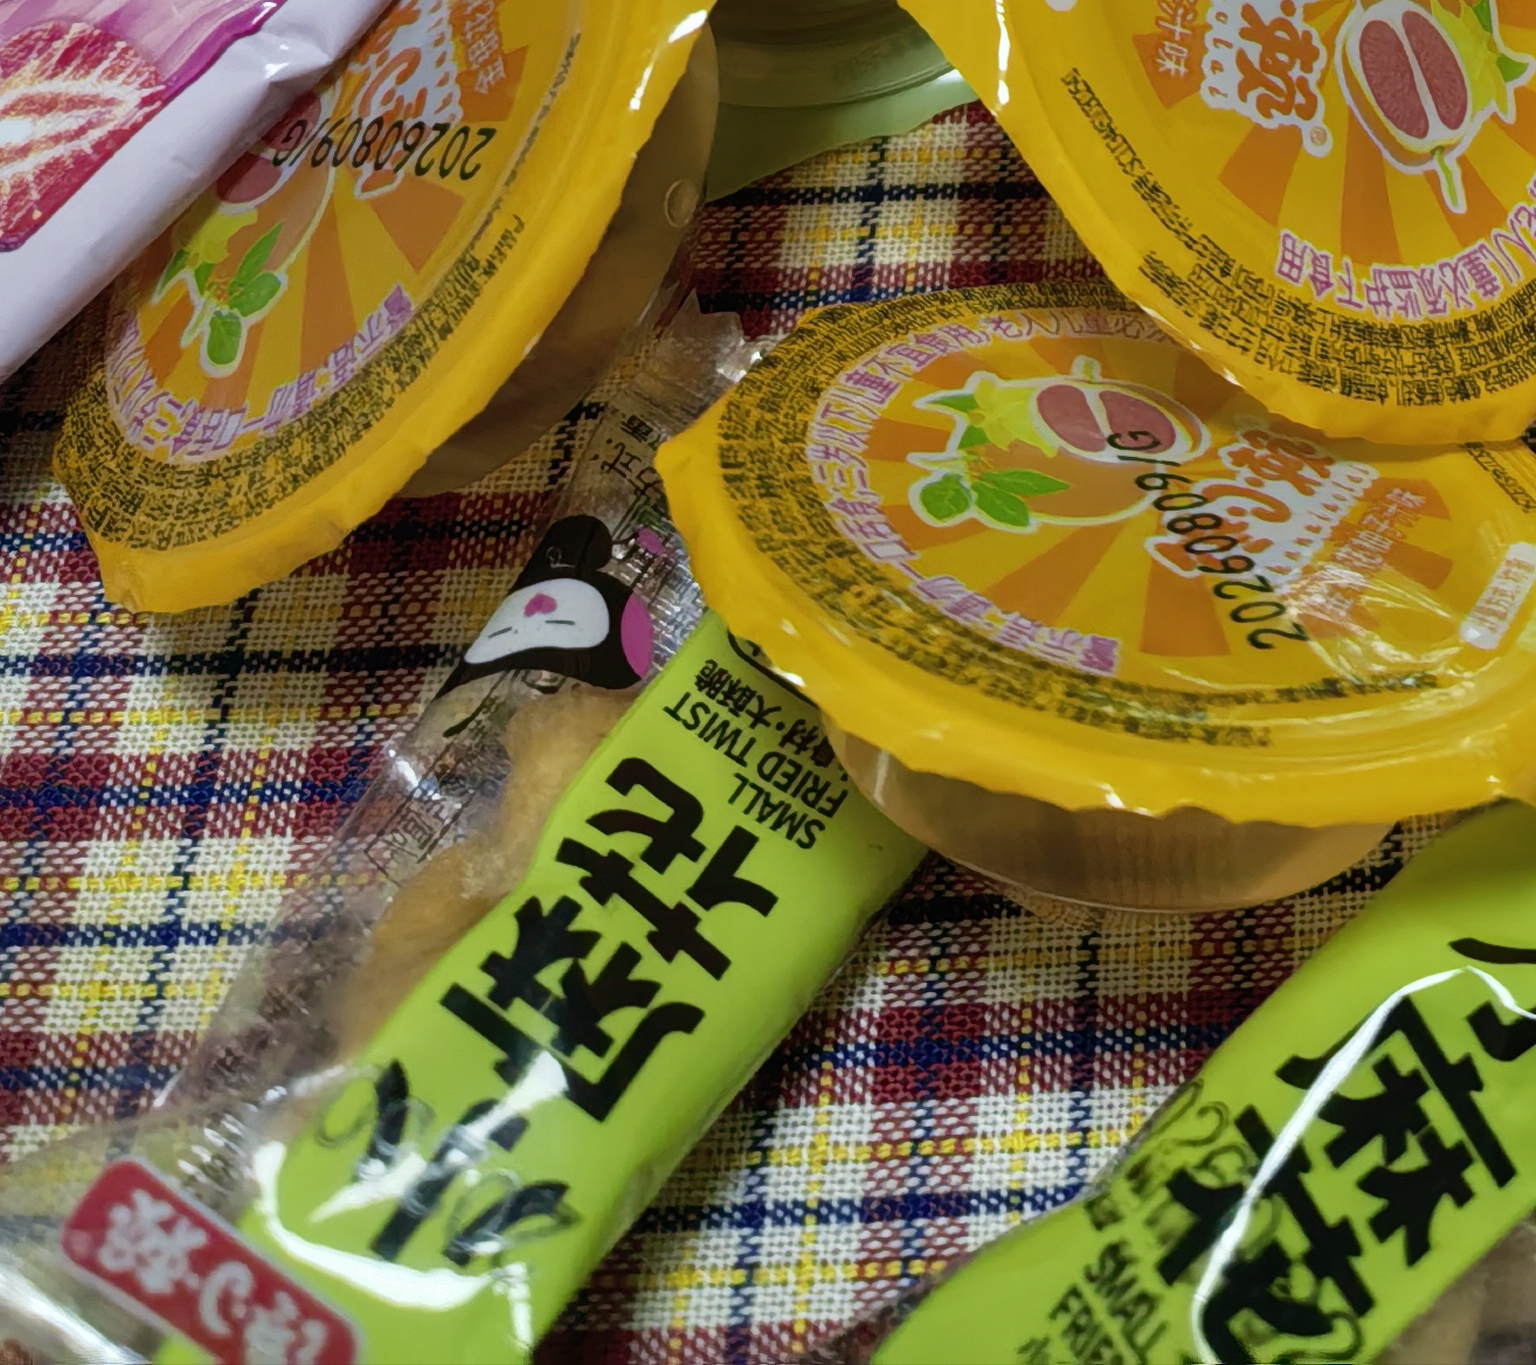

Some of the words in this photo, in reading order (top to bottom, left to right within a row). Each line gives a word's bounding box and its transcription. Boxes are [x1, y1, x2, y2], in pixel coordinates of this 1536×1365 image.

[271, 122, 497, 180] 20260809/G
[1107, 429, 1307, 652] 20260809/G
[663, 692, 747, 764] TWIST
[728, 779, 825, 851] SMALL
[750, 743, 850, 830] FRIED
[315, 755, 779, 1265] 小麻花
